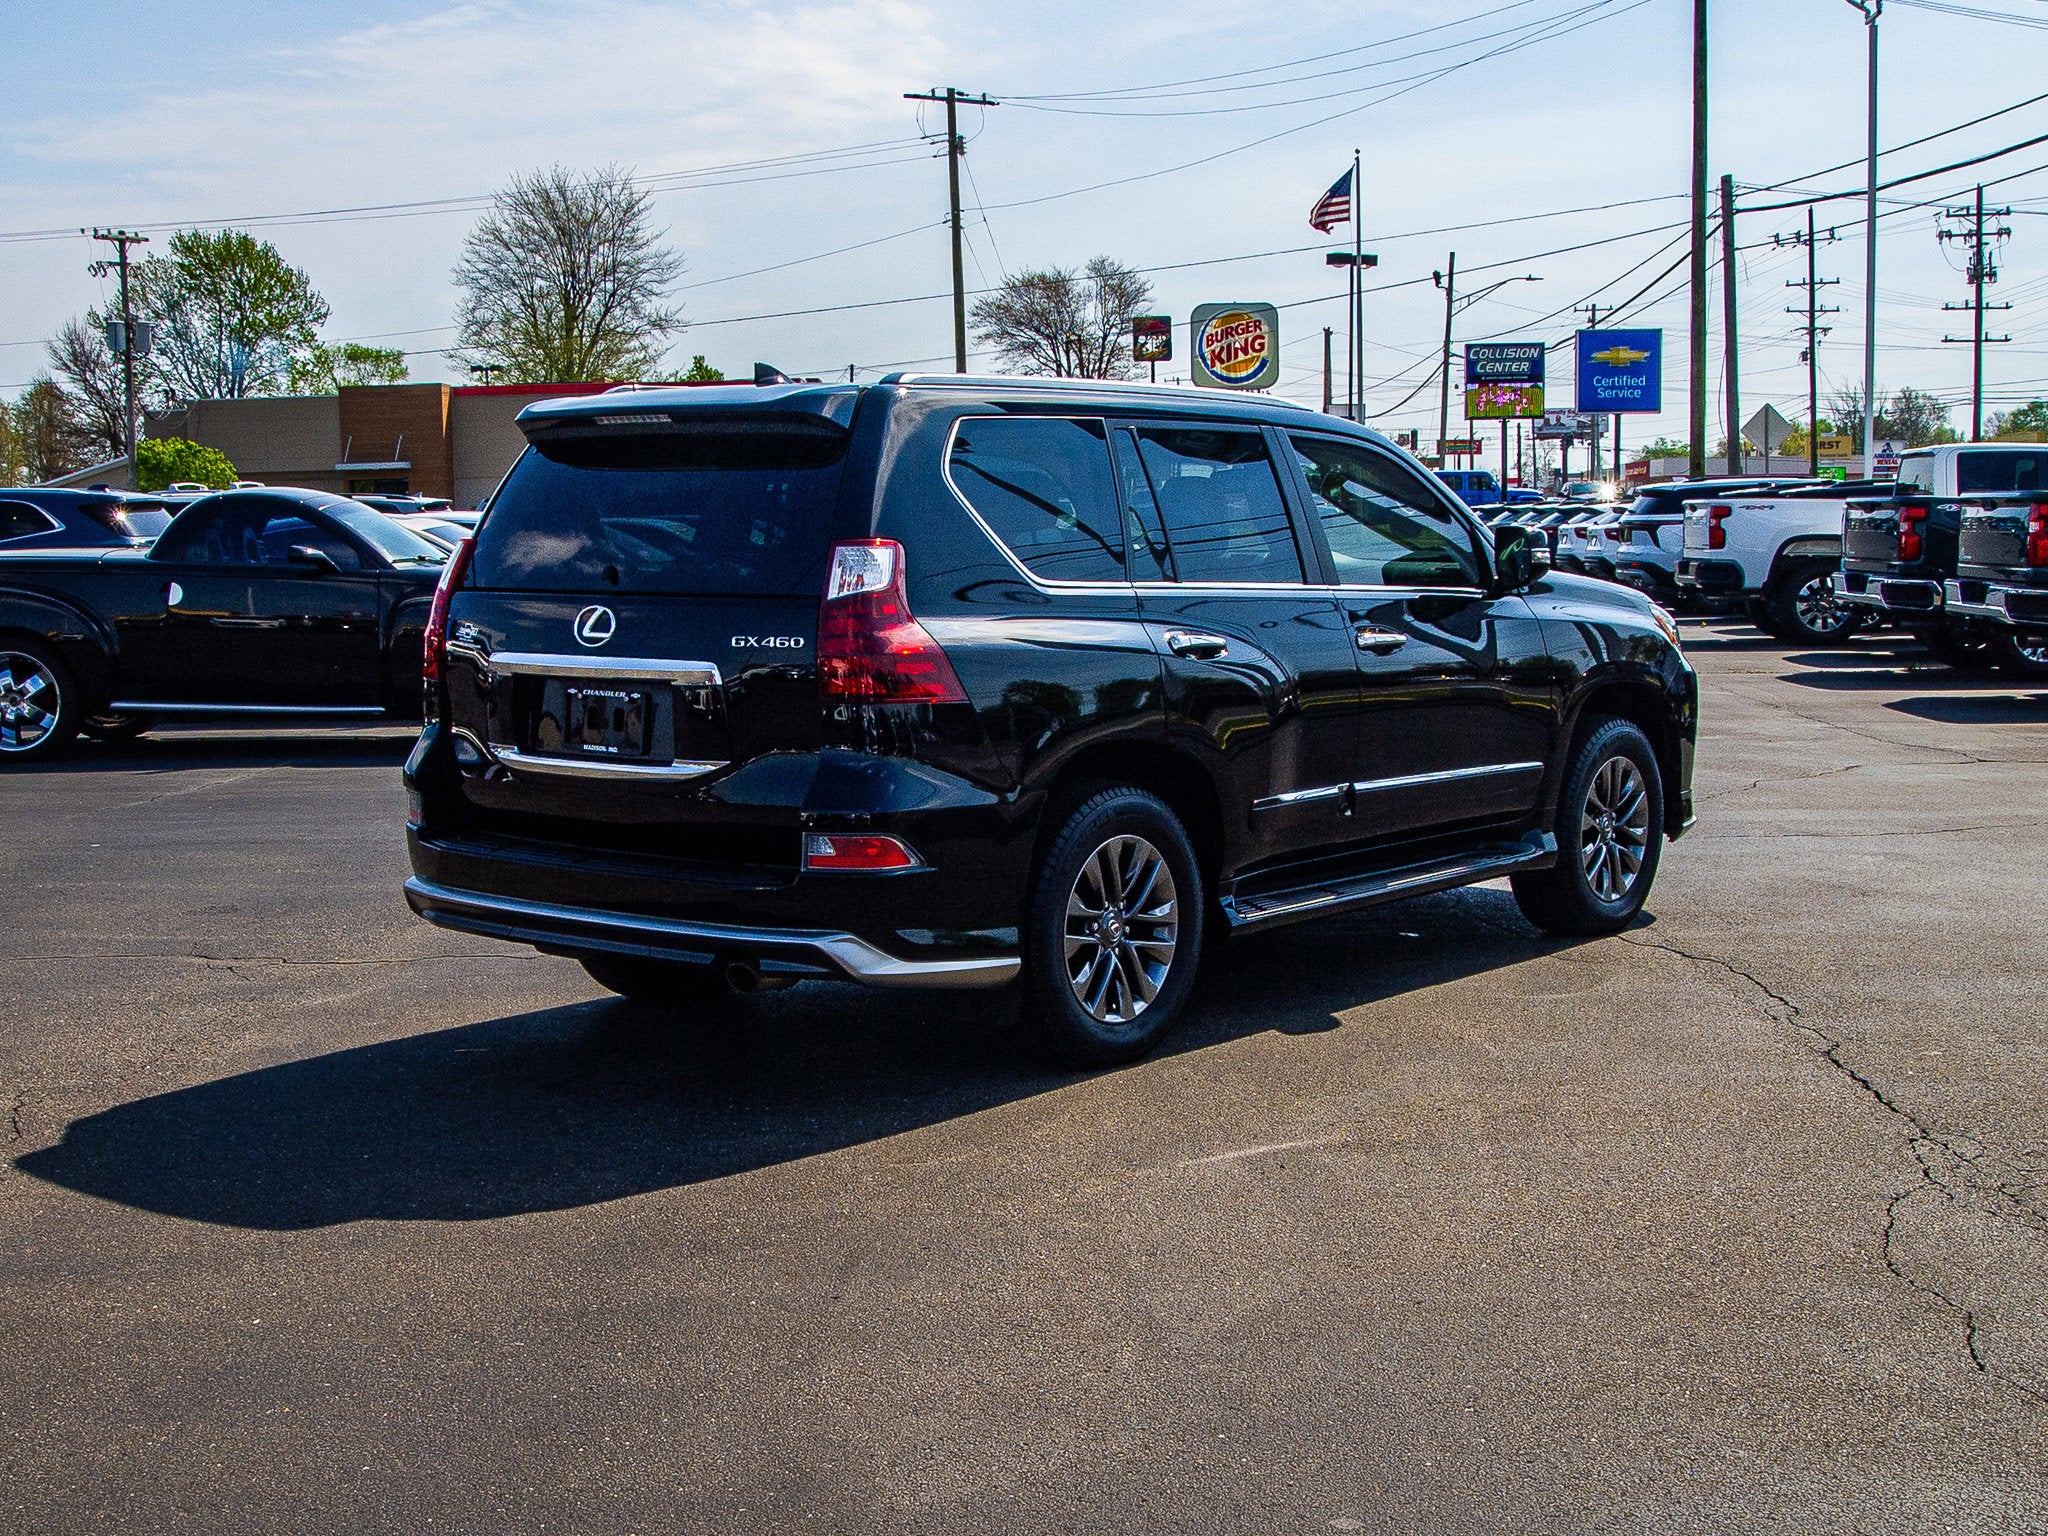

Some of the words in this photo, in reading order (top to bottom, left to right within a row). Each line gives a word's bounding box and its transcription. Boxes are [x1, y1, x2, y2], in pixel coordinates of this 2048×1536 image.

[1205, 319, 1263, 349] BURGER
[1210, 334, 1266, 369] KING
[1469, 347, 1540, 359] COLLISION
[1476, 361, 1530, 373] CENTER
[1593, 375, 1646, 387] Certified
[1597, 387, 1642, 399] Service
[582, 689, 627, 698] CHANDLER
